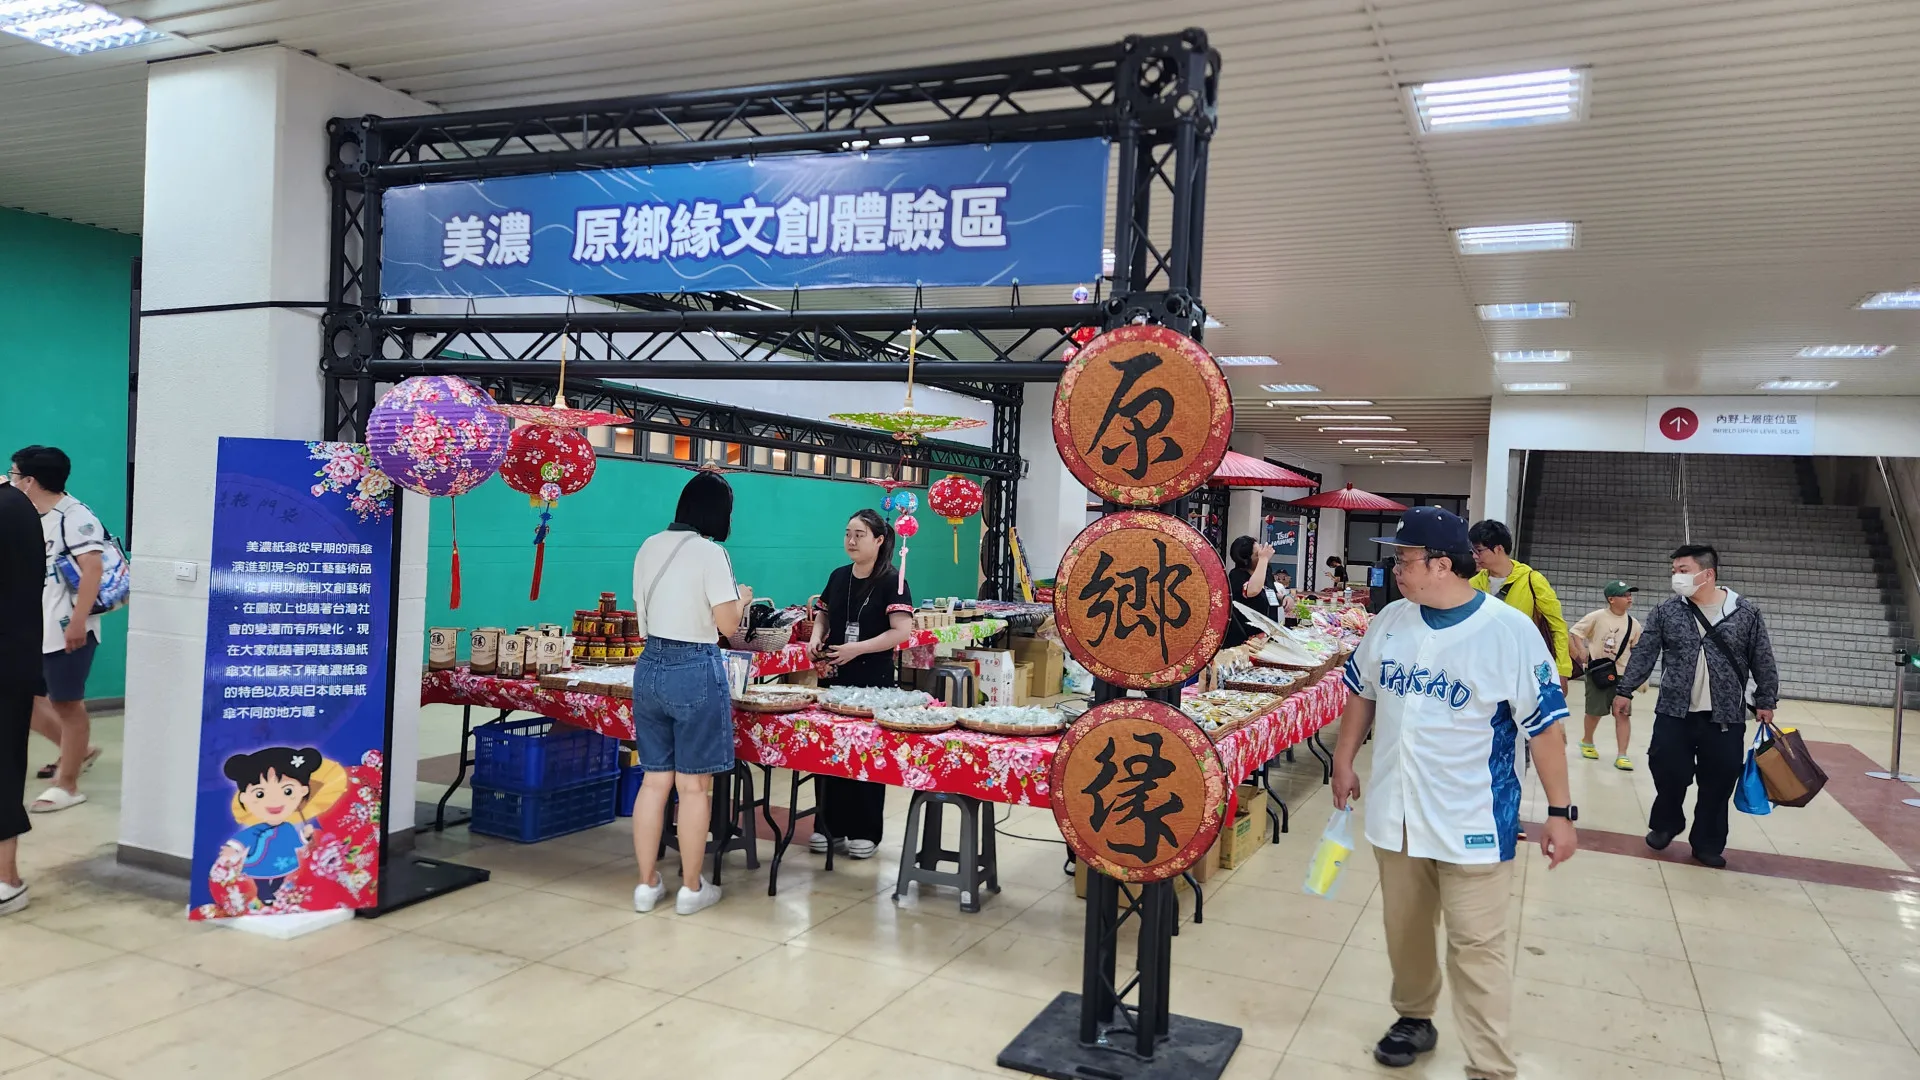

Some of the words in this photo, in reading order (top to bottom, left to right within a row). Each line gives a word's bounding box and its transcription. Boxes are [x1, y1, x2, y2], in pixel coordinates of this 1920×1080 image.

[441, 210, 532, 269] 美濃
[571, 185, 1010, 265] 原鄉緣文創體驗區
[1085, 352, 1184, 481] 原
[1716, 414, 1798, 425] 內野上層座位區
[245, 540, 373, 555] 美濃紙傘從早期的雨傘
[1078, 538, 1192, 665] 鄉
[1380, 658, 1473, 711] TAKAO
[1080, 732, 1184, 864] 緣
